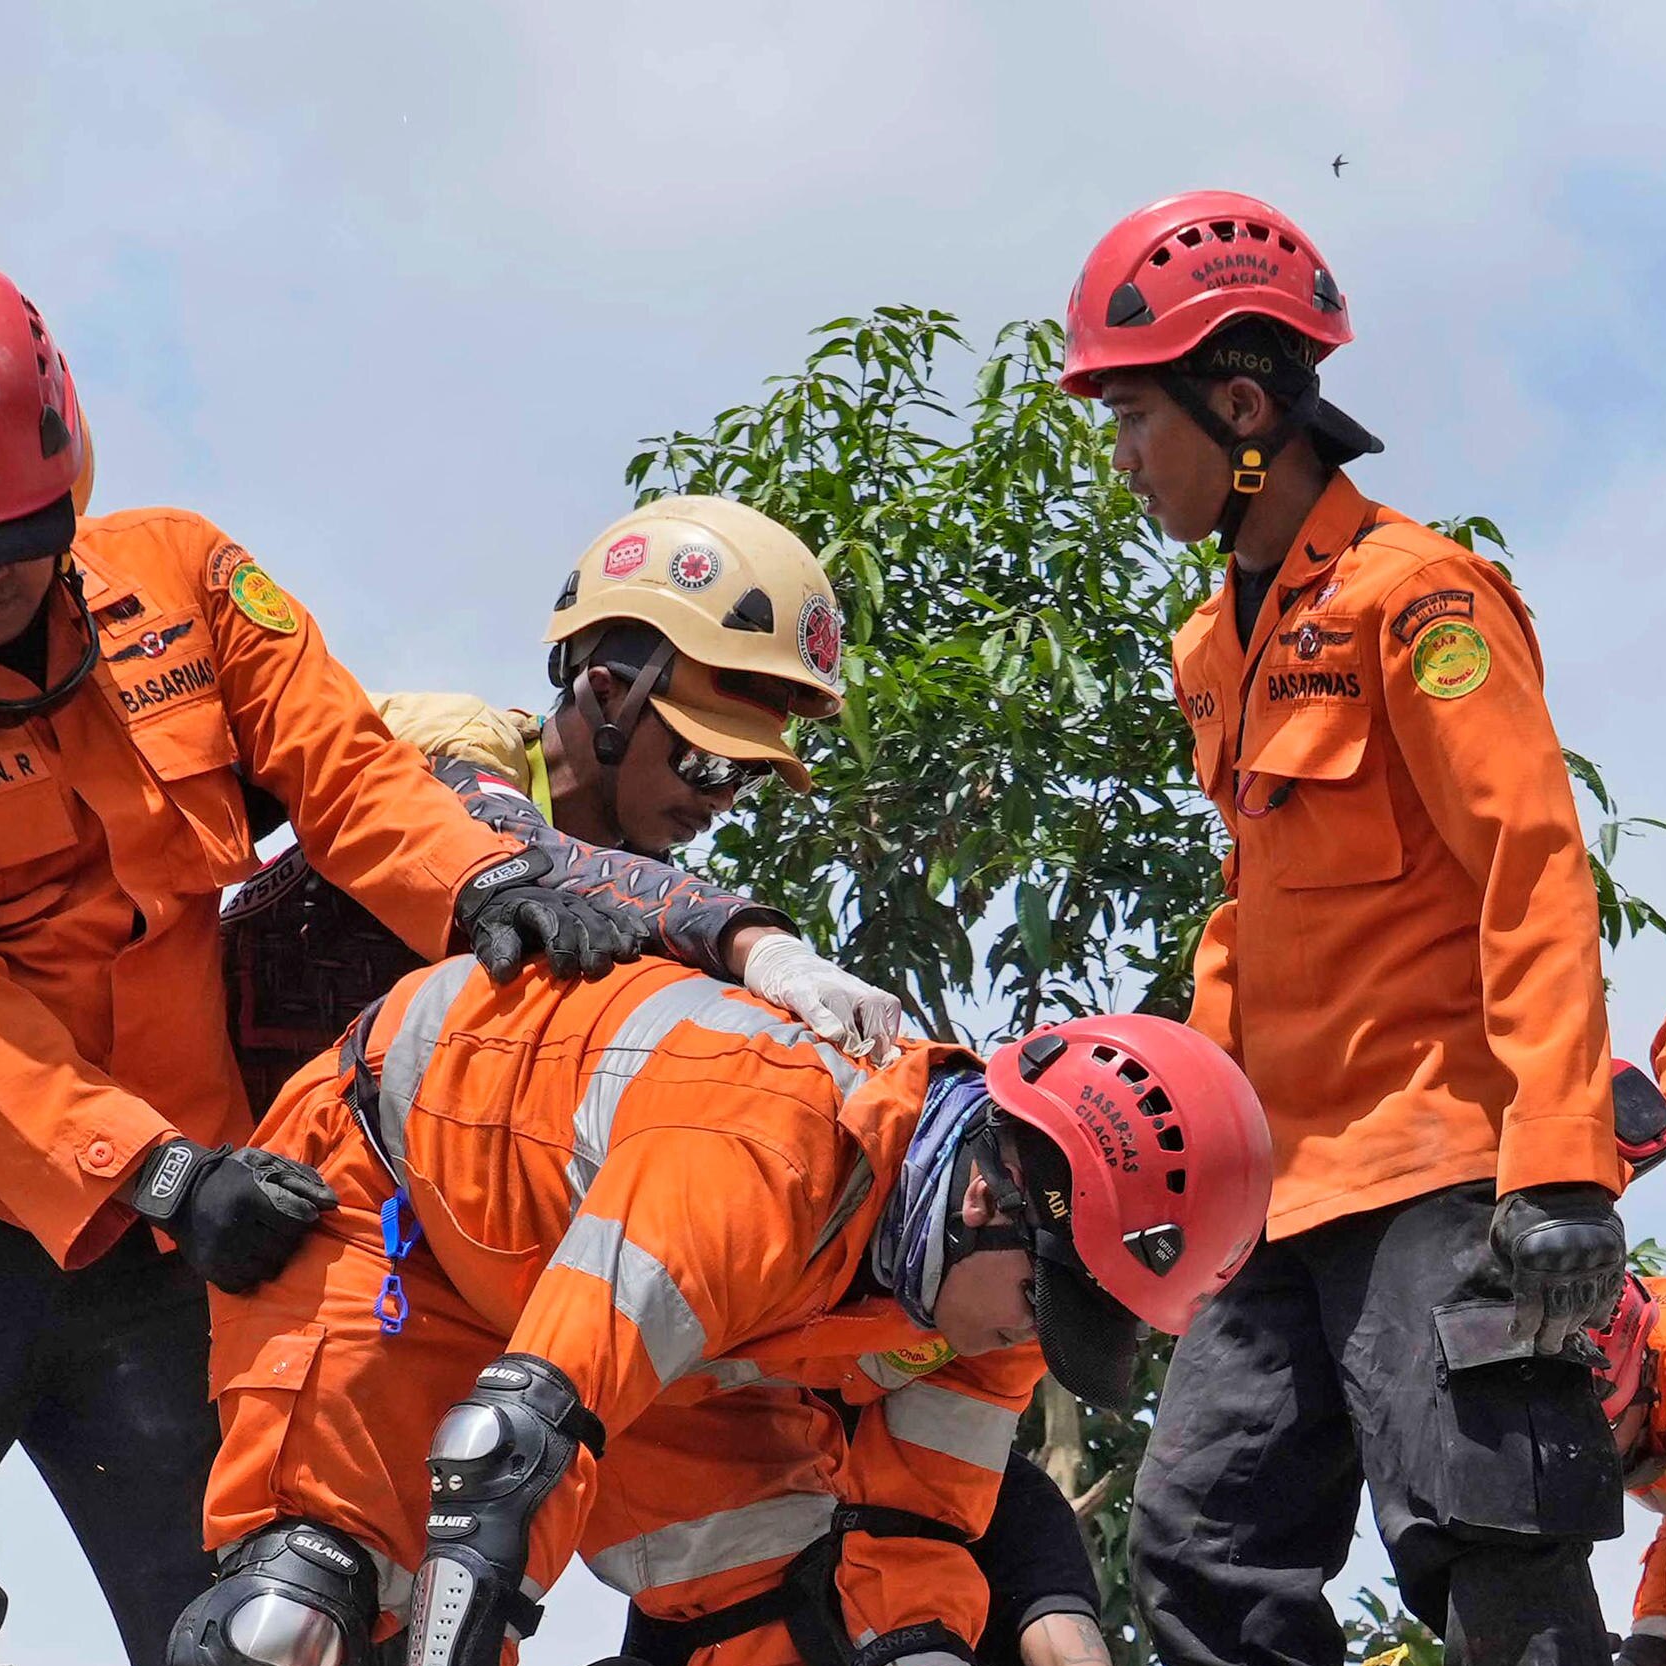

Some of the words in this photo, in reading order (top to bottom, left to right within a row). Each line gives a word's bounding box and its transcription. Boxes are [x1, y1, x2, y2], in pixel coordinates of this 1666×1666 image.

[1192, 254, 1279, 282] BASARNAS
[1212, 349, 1273, 373] ARGO
[1434, 635, 1458, 652] SAR
[118, 656, 216, 713] BASARNAS
[1267, 672, 1362, 701] BASARNAS
[474, 857, 530, 890] PETZL
[1075, 1104, 1119, 1169] CILACAP
[428, 1515, 473, 1528] SULAITE
[293, 1535, 354, 1569] SULAITE
